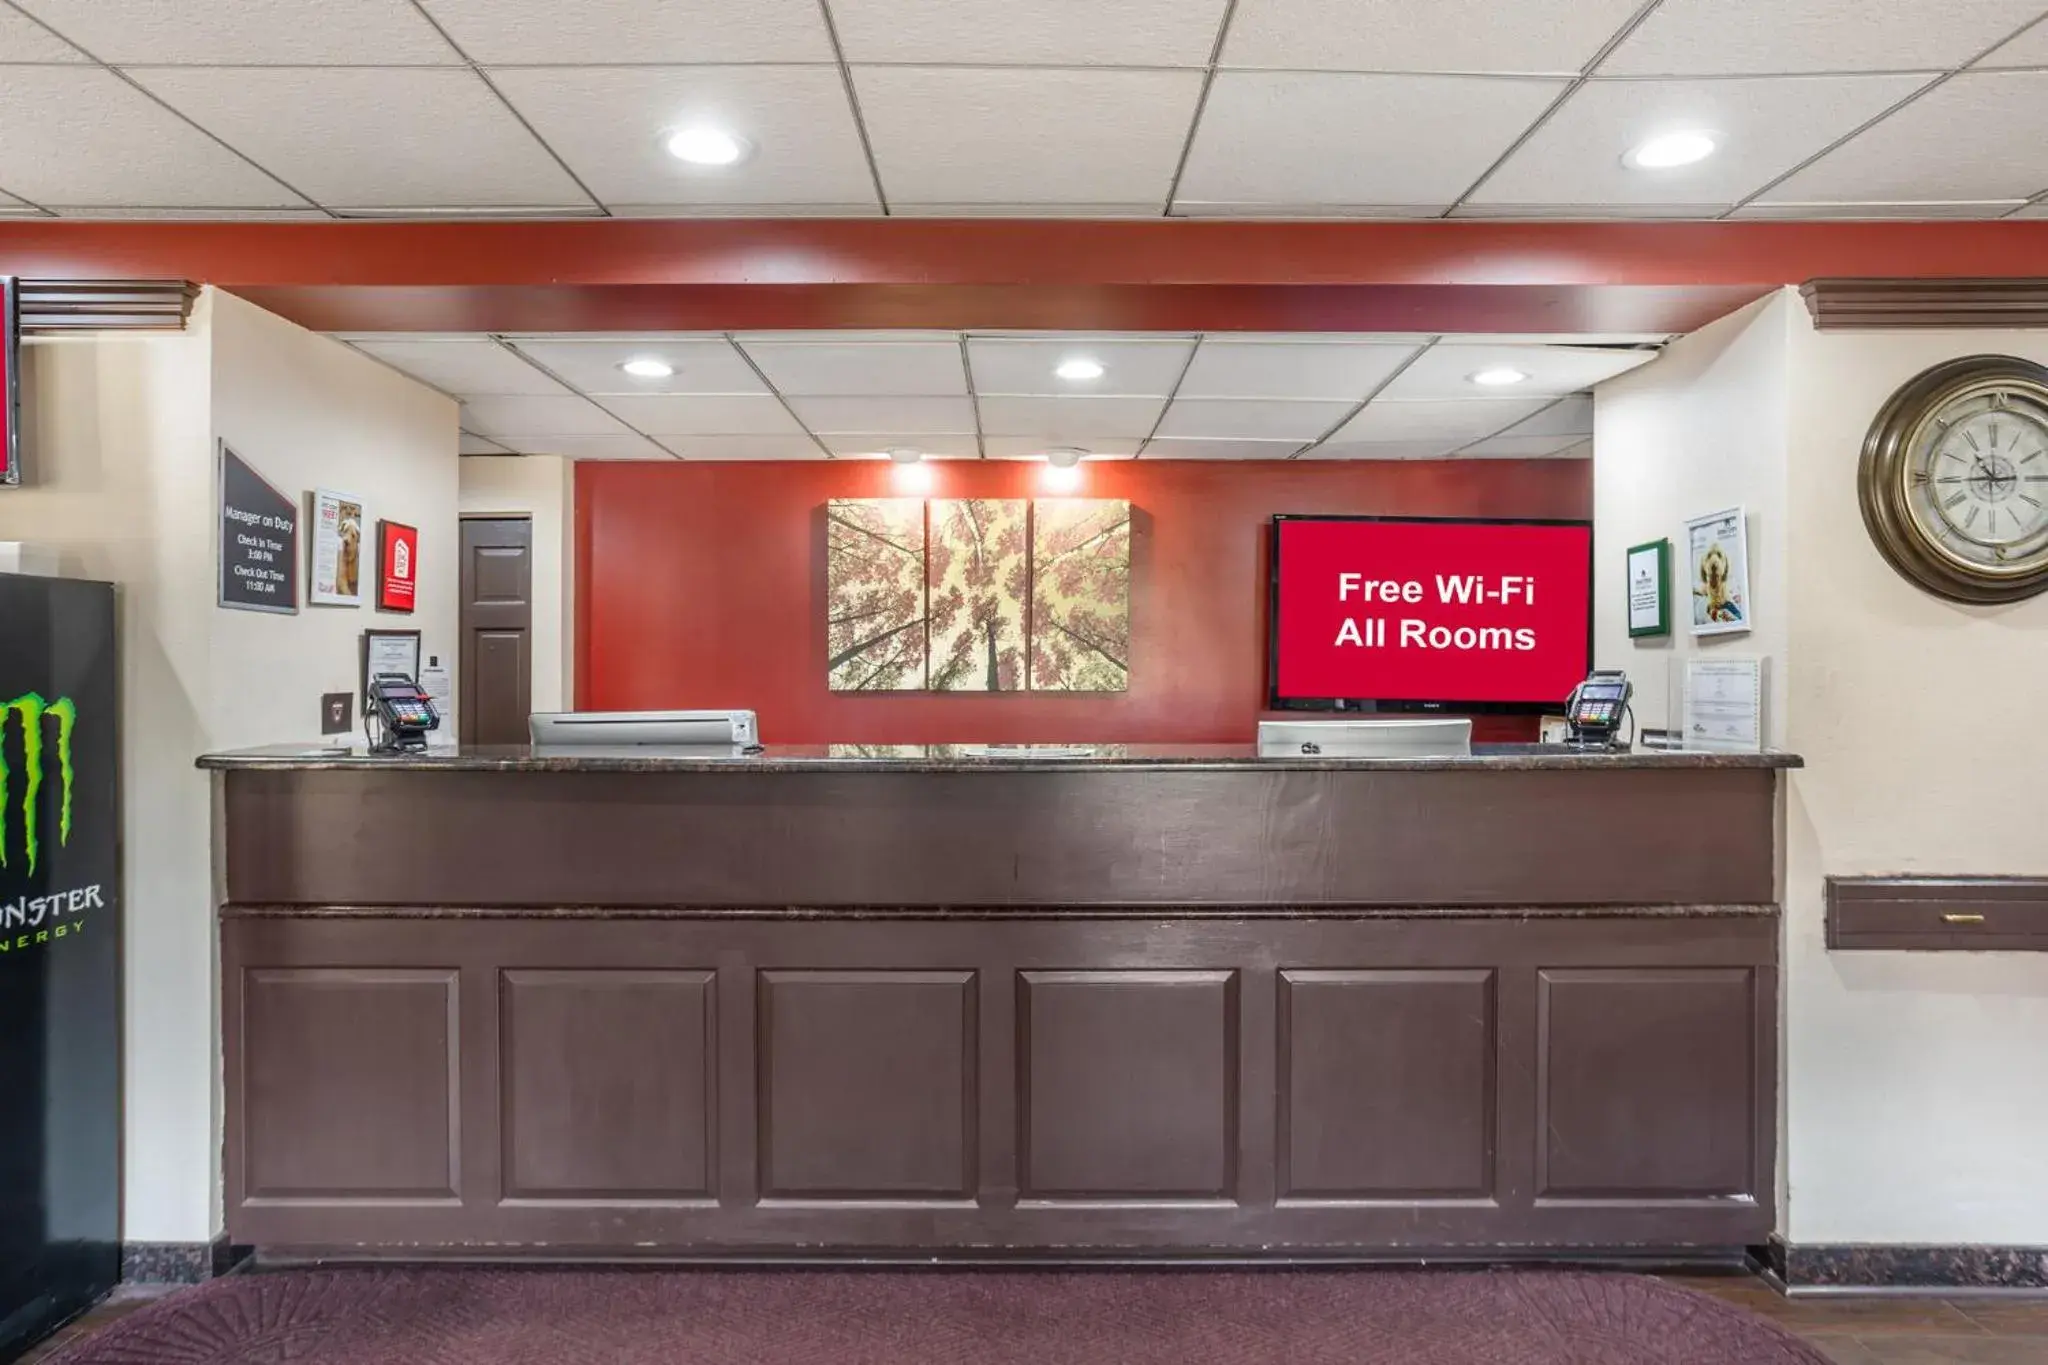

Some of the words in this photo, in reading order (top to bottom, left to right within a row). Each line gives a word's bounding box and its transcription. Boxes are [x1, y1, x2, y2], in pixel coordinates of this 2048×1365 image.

[225, 504, 261, 527] Manager
[263, 516, 274, 527] on
[275, 516, 293, 534] Duty
[237, 533, 257, 547] Check
[259, 538, 266, 548] In
[267, 539, 284, 551] Time
[263, 551, 273, 562] PM
[234, 564, 255, 577] Check
[256, 568, 268, 579] Out
[269, 570, 285, 581] Time
[265, 583, 275, 593] AM
[1338, 572, 1423, 603] Free
[1435, 575, 1534, 605] Wi-Fi
[1334, 617, 1385, 647] All
[1400, 619, 1536, 650] Rooms
[0, 884, 104, 929] NSTER
